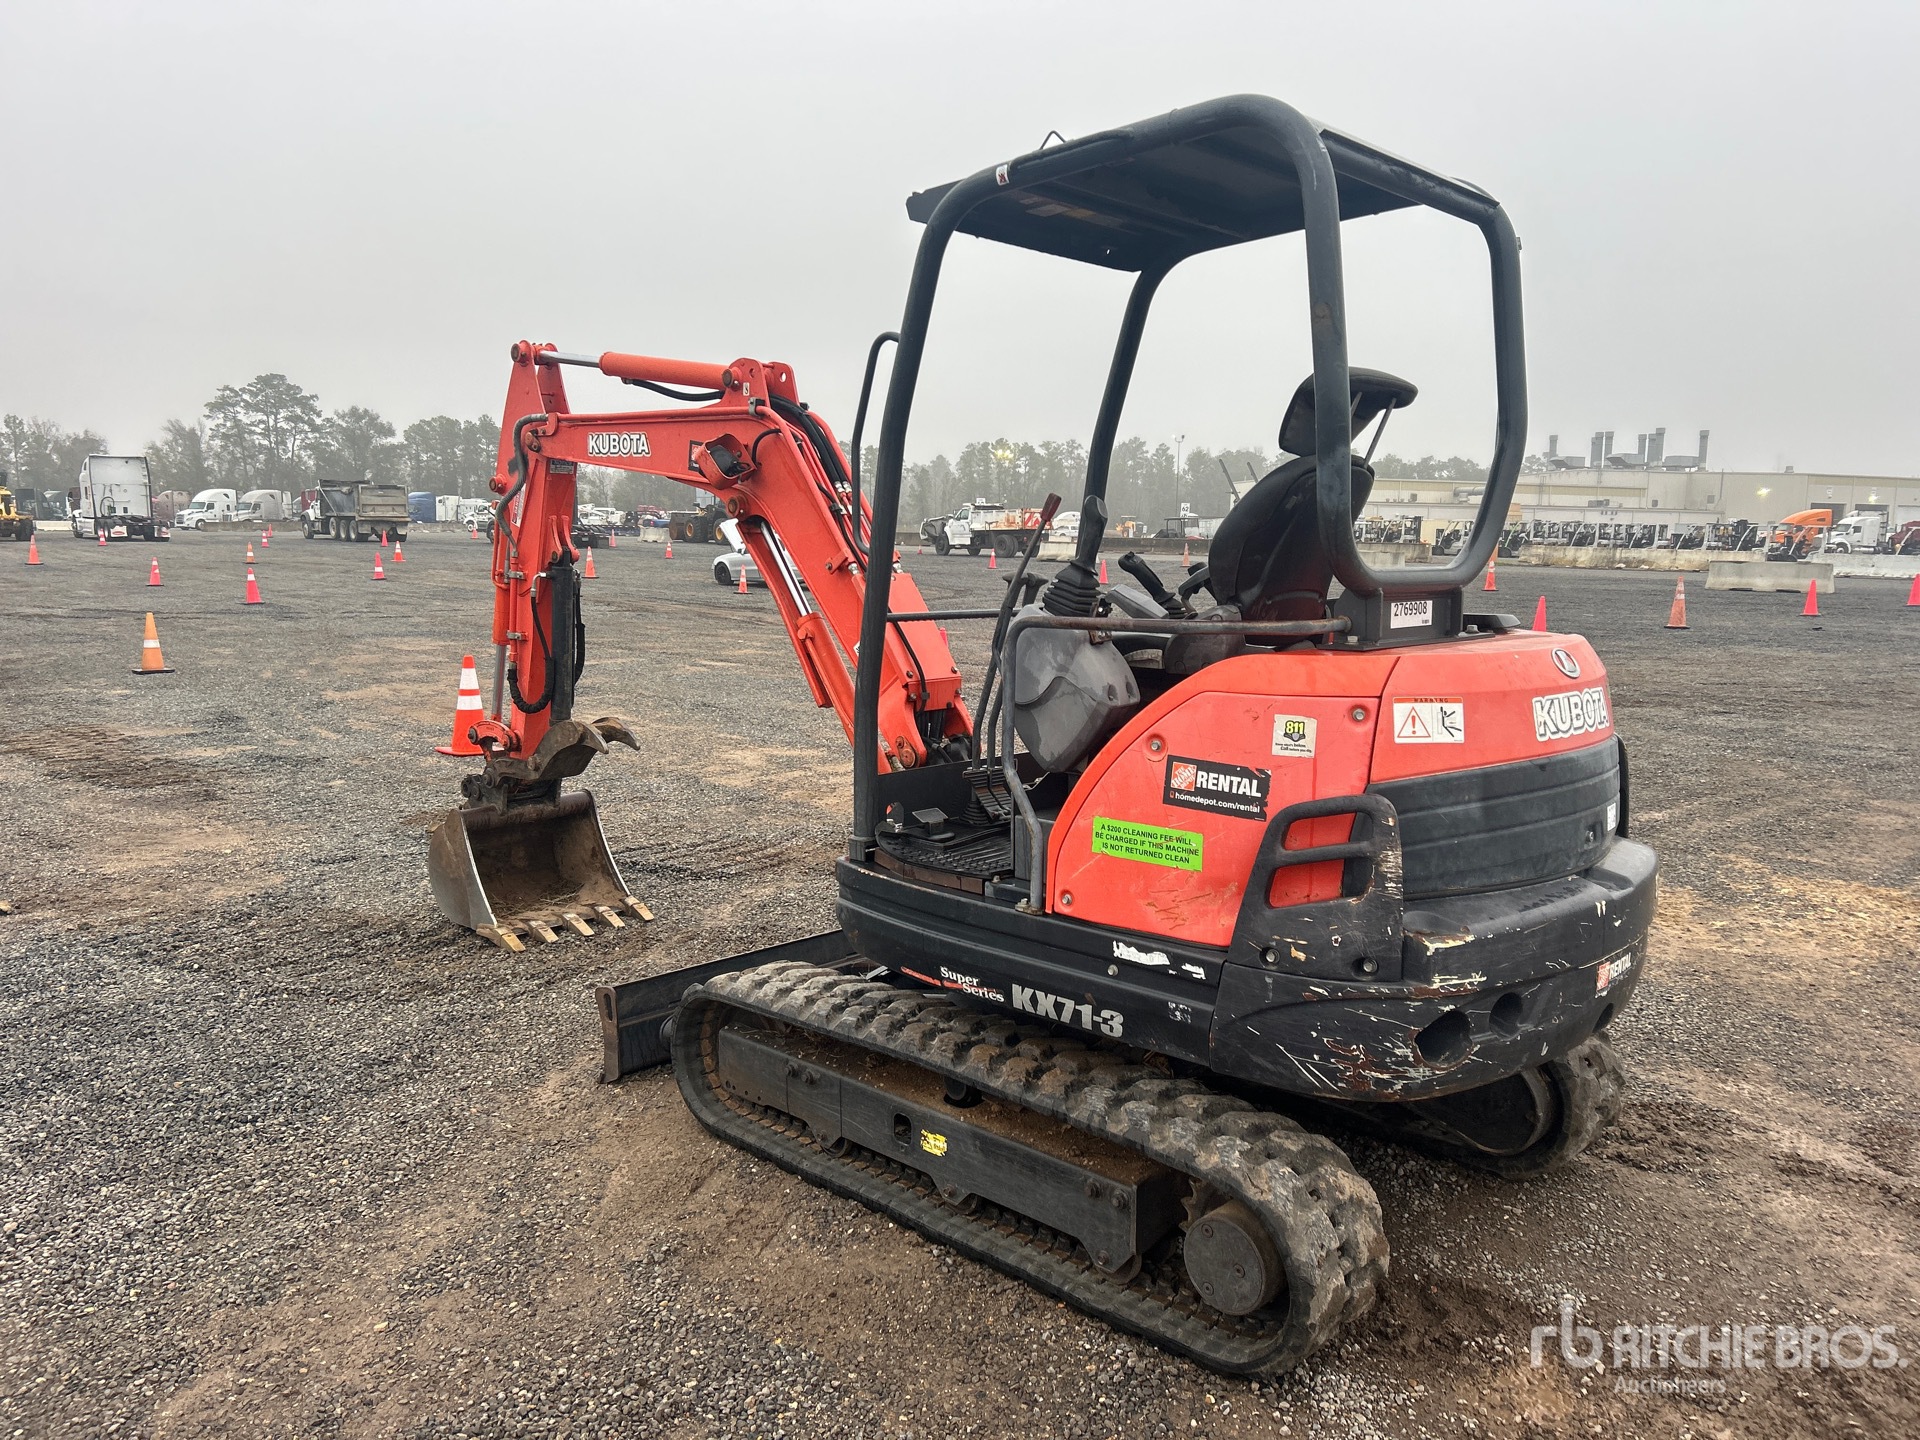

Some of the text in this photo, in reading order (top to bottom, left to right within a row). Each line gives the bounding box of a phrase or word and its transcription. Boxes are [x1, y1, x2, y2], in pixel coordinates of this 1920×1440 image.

[588, 433, 650, 456] KUBOTA
[1393, 601, 1428, 616] 2769908
[1533, 688, 1609, 738] KUBOTA
[1285, 720, 1304, 734] 811
[1196, 770, 1262, 798] RENTAL
[1175, 791, 1260, 813] homedepot.com/rental
[1105, 833, 1139, 845] CHARGED
[1148, 841, 1164, 850] THIS
[1165, 844, 1199, 856] MACHINE
[1106, 824, 1122, 833] $200
[1122, 827, 1158, 840] CLEANING
[1159, 834, 1174, 843] FEE
[1175, 836, 1192, 846] WILL
[1109, 843, 1124, 852] NOT
[1125, 845, 1163, 859] RETURNED
[1164, 853, 1190, 864] CLEAN
[940, 965, 979, 987] Super
[1609, 952, 1631, 980] RENTAL
[962, 982, 1005, 1003] Series
[1011, 983, 1124, 1038] KX71-3
